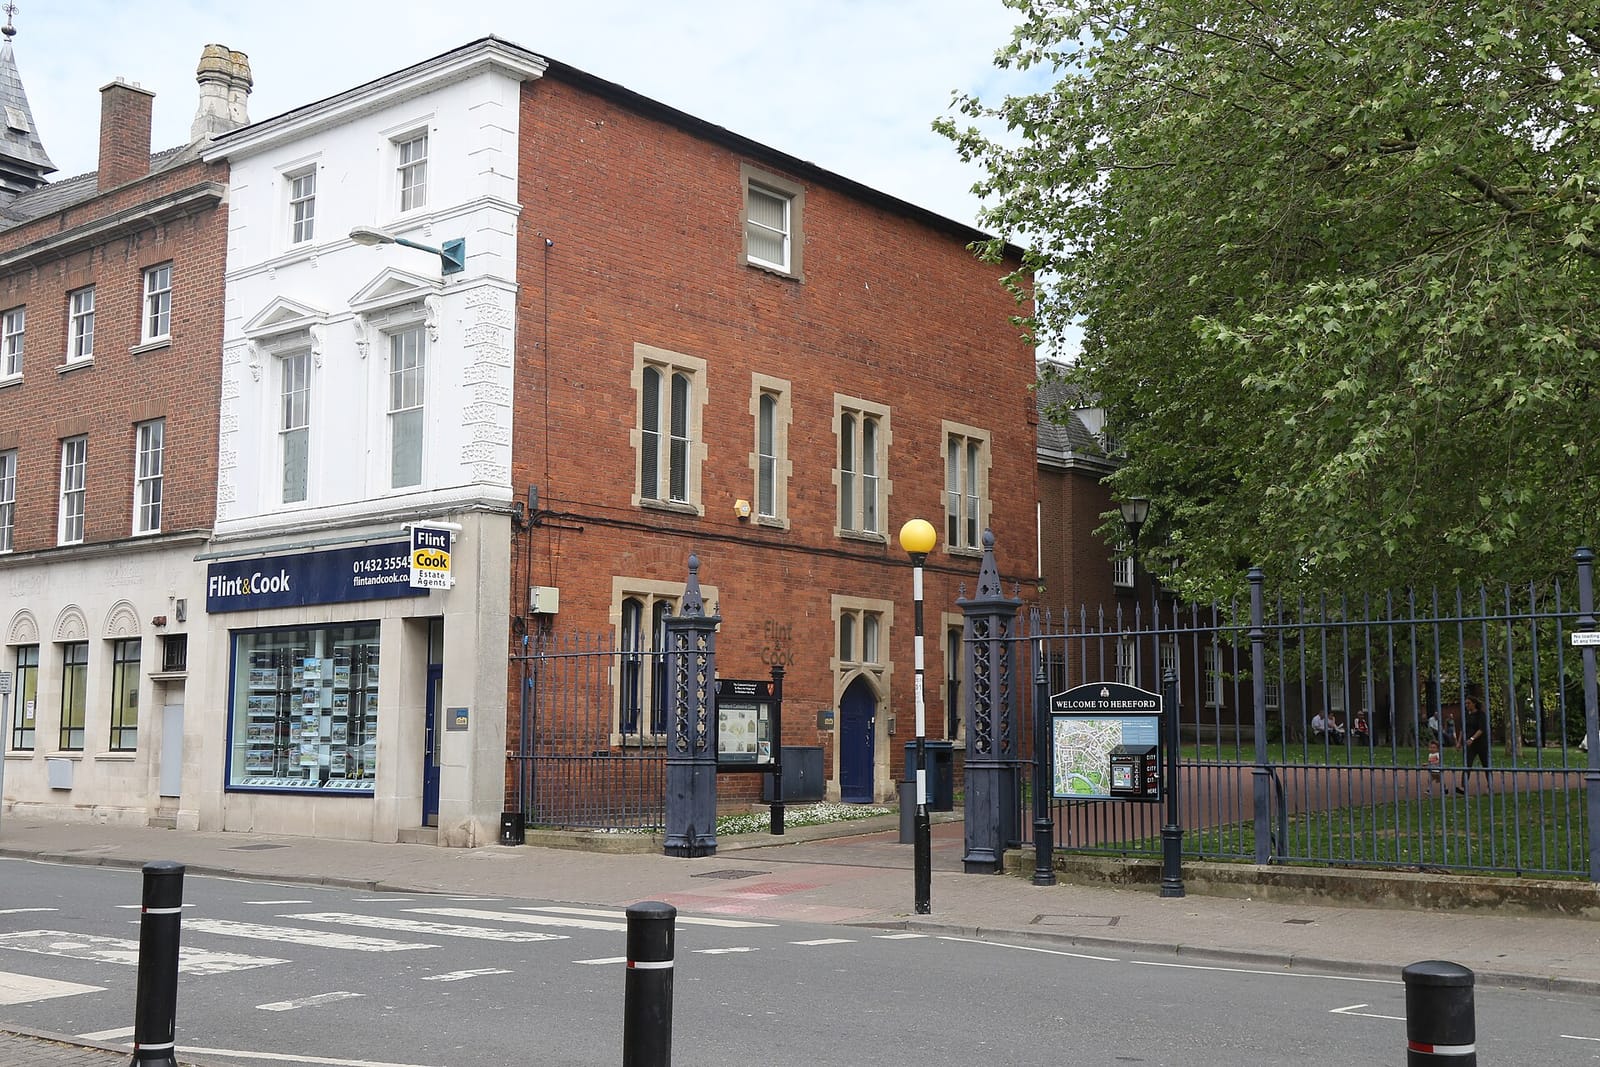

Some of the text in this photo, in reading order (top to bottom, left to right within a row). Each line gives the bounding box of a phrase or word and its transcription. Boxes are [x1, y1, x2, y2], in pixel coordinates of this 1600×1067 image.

[418, 532, 445, 547] Flint
[353, 558, 382, 573] 01432
[417, 553, 447, 568] Cook
[417, 577, 446, 587] Agents
[419, 570, 445, 579] Estate
[209, 569, 290, 597] Flint&Cook
[764, 619, 792, 640] Flint
[761, 646, 794, 666] Cook
[1110, 700, 1156, 708] HEREFORD
